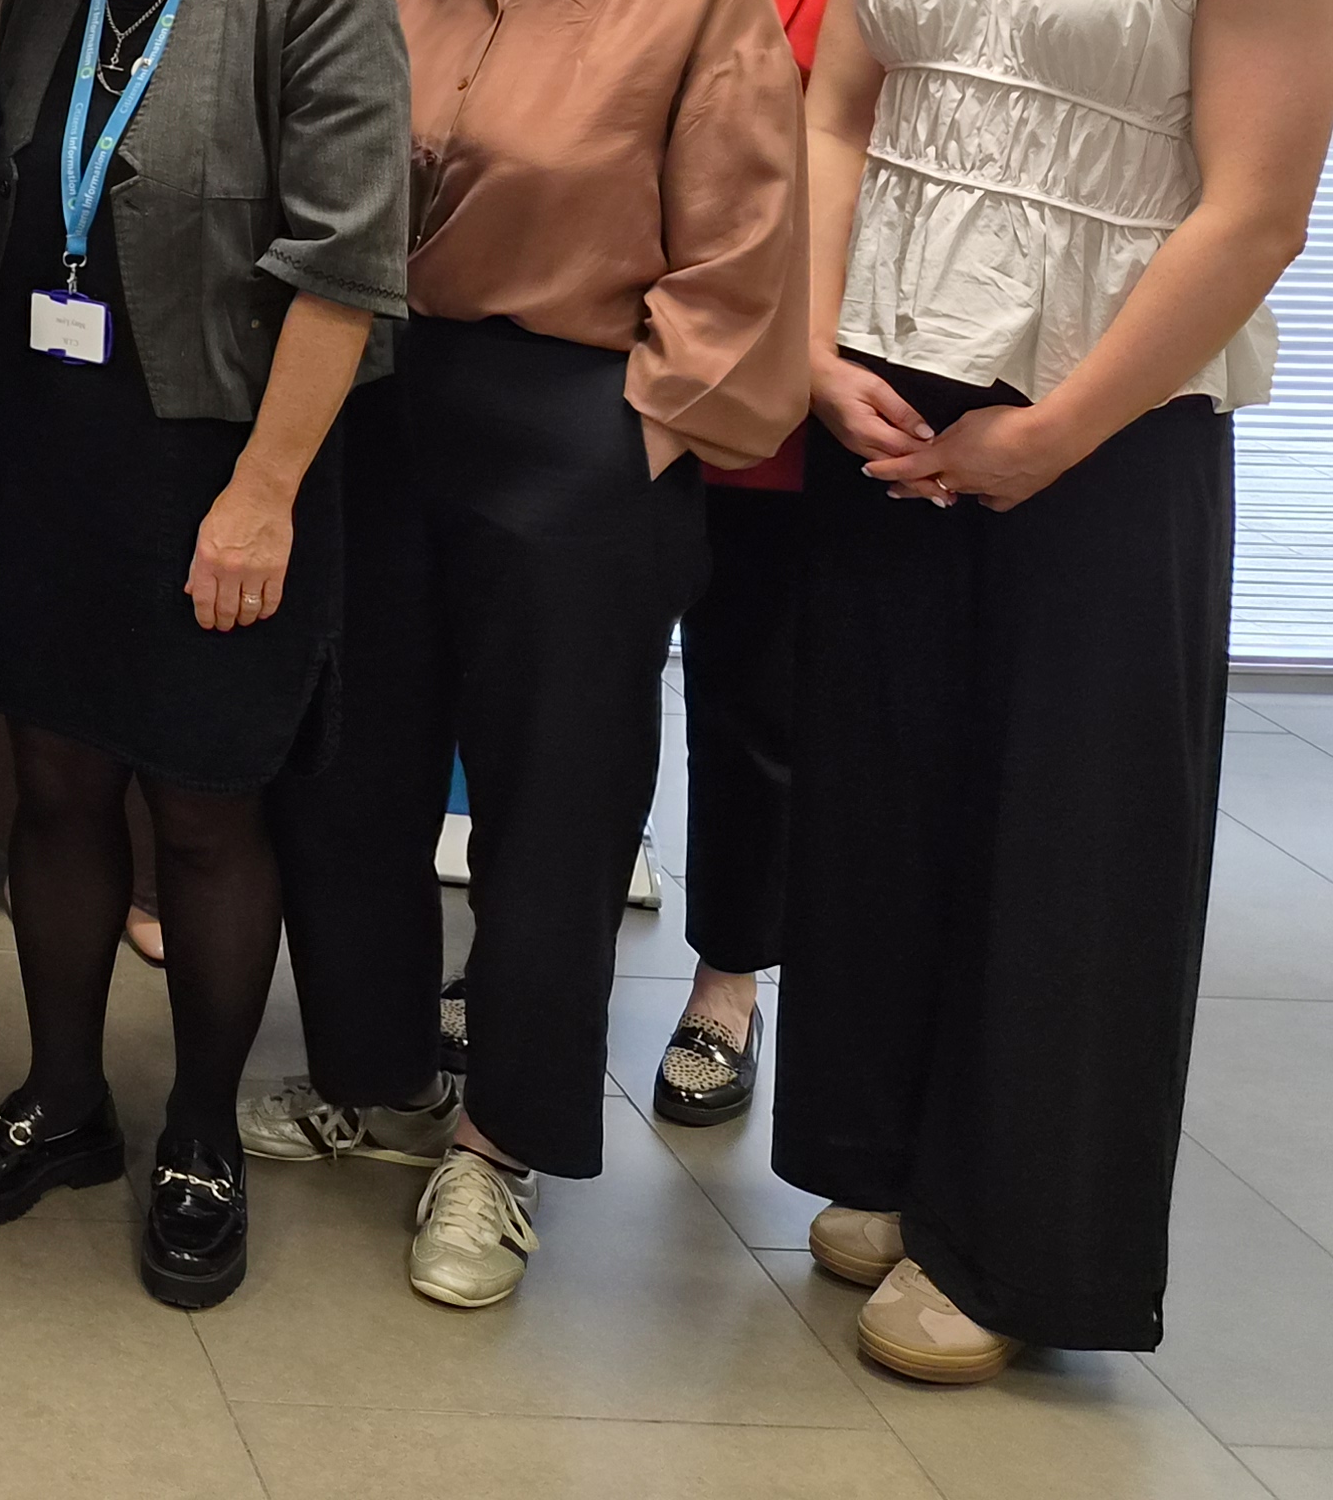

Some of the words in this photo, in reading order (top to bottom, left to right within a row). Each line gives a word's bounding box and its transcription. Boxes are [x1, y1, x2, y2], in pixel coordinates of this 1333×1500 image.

[83, 11, 99, 66] Information
[136, 27, 169, 82] Inmation
[67, 137, 78, 196] Information
[82, 150, 107, 209] Information
